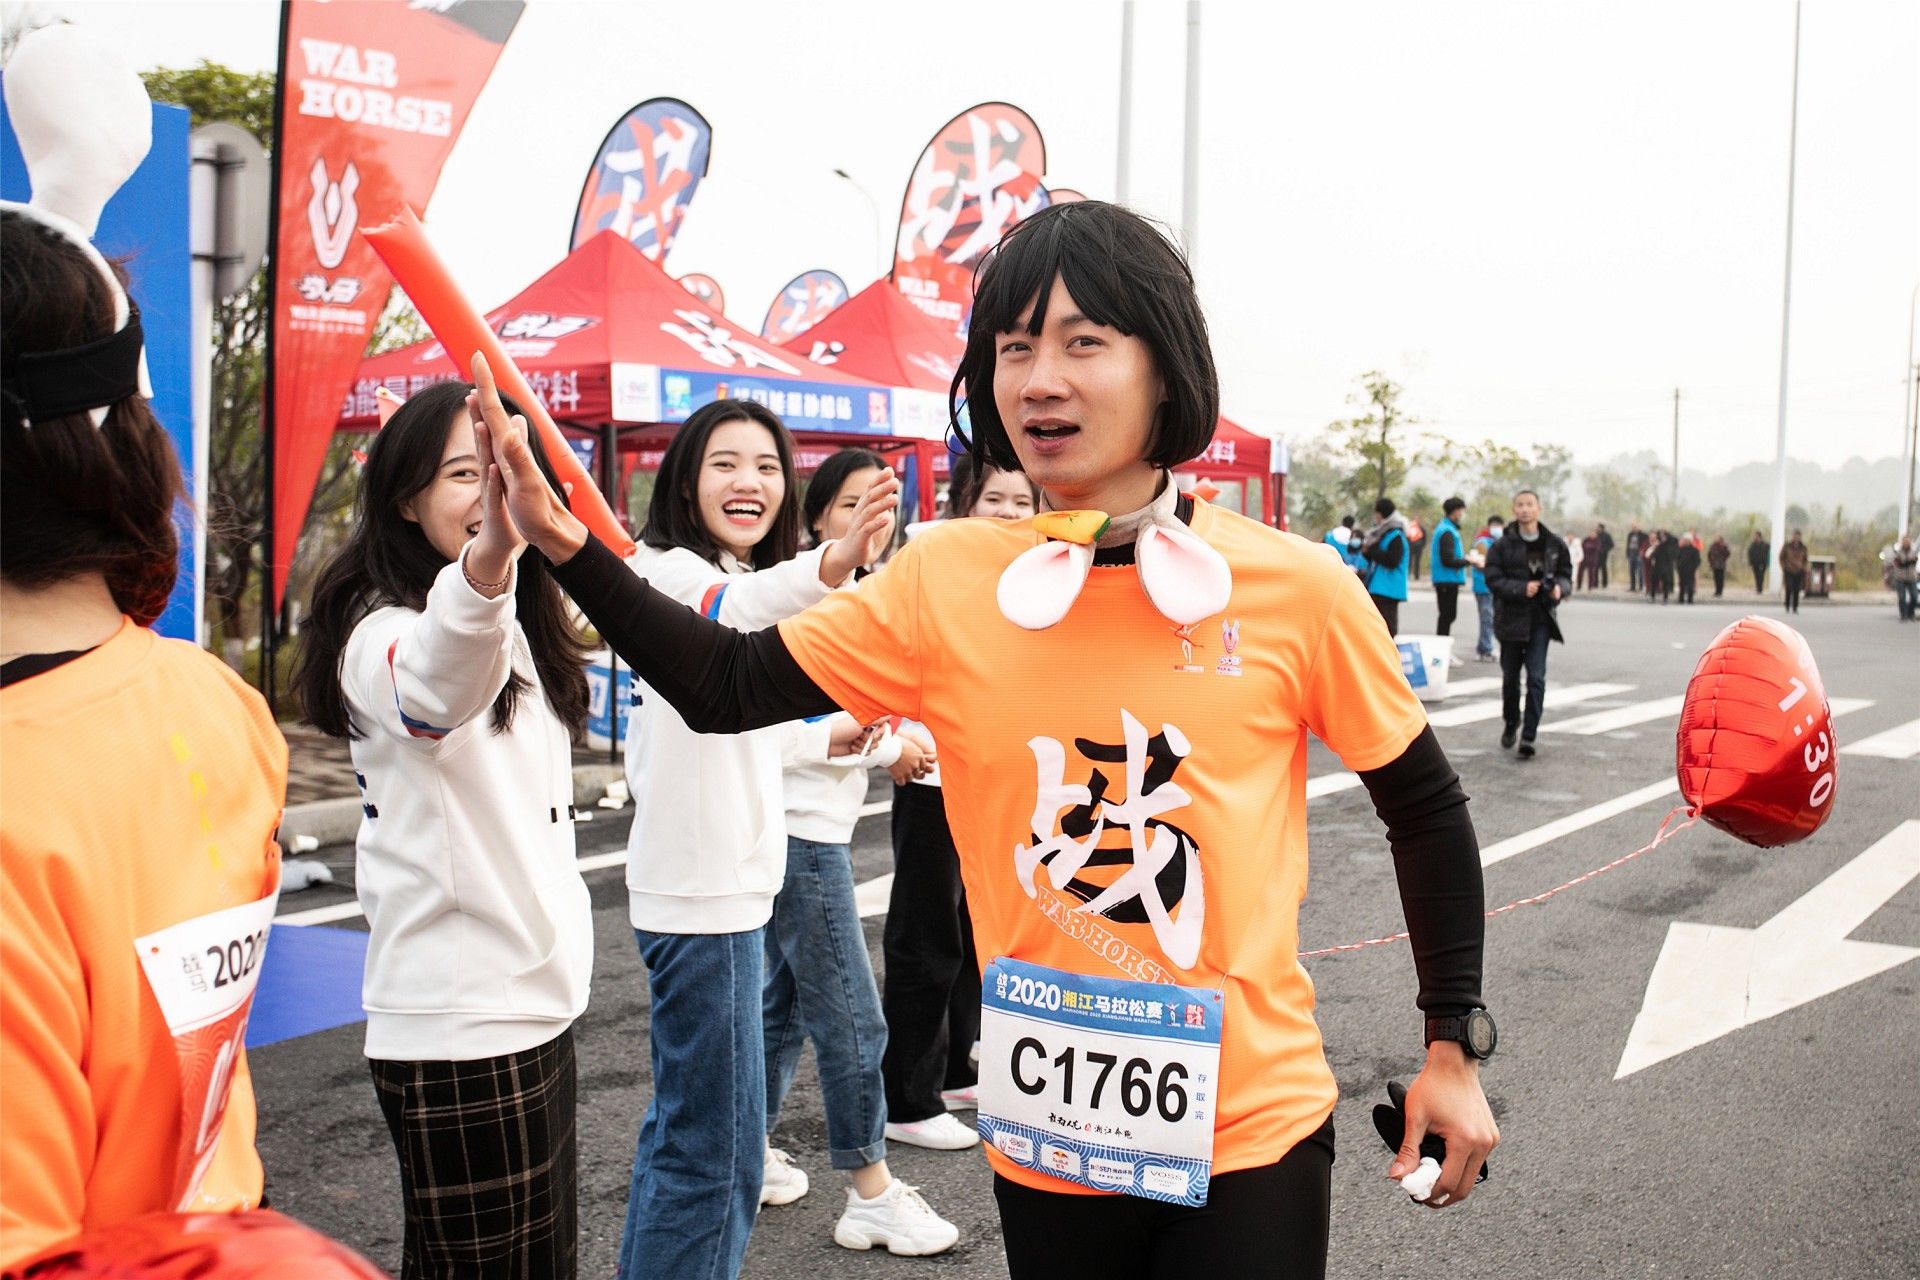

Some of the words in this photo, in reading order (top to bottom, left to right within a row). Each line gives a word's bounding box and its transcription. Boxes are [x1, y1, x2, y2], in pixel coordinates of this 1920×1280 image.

[299, 38, 398, 88] WAR
[299, 80, 453, 137] HORSE
[897, 275, 941, 299] WAR
[1778, 676, 1833, 808] 1:30
[1038, 884, 1088, 940] WAR
[1008, 975, 1061, 1011] 2020
[1062, 989, 1163, 1020] 湘江马拉松赛
[1133, 1016, 1162, 1025] MARATHON
[1010, 1037, 1189, 1123] C1766
[1150, 1170, 1182, 1181] VOSS
